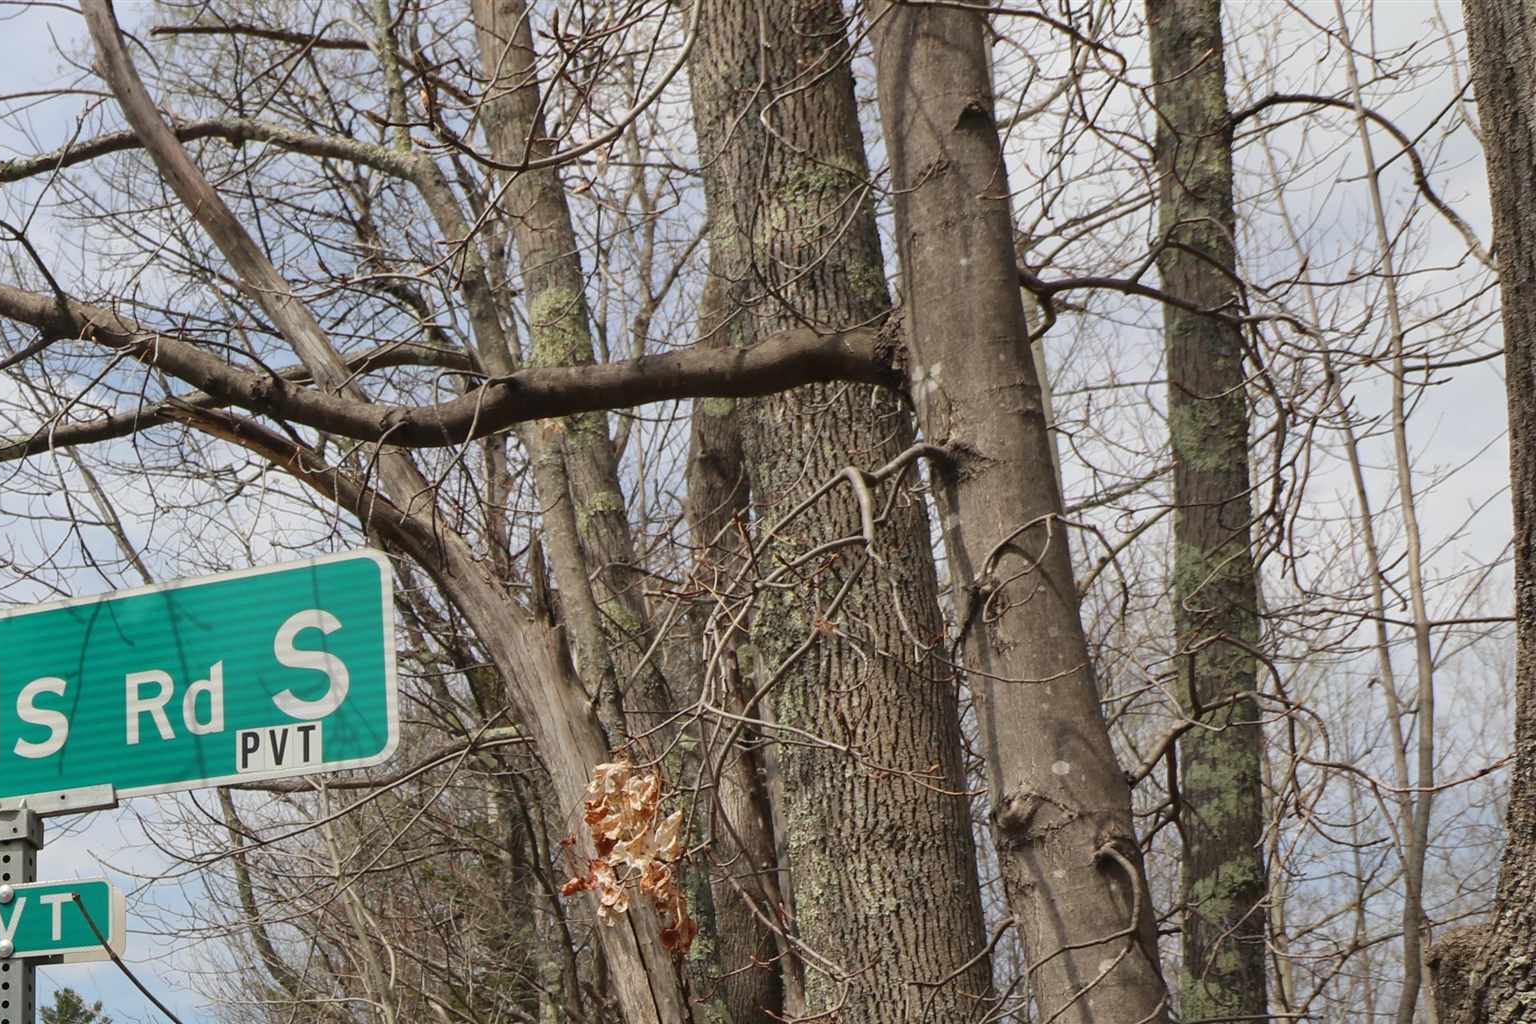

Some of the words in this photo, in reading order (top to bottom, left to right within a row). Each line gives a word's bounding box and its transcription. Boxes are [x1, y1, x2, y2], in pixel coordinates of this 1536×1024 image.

[125, 660, 224, 745] Rd
[272, 609, 350, 720] S
[241, 726, 318, 770] PVT
